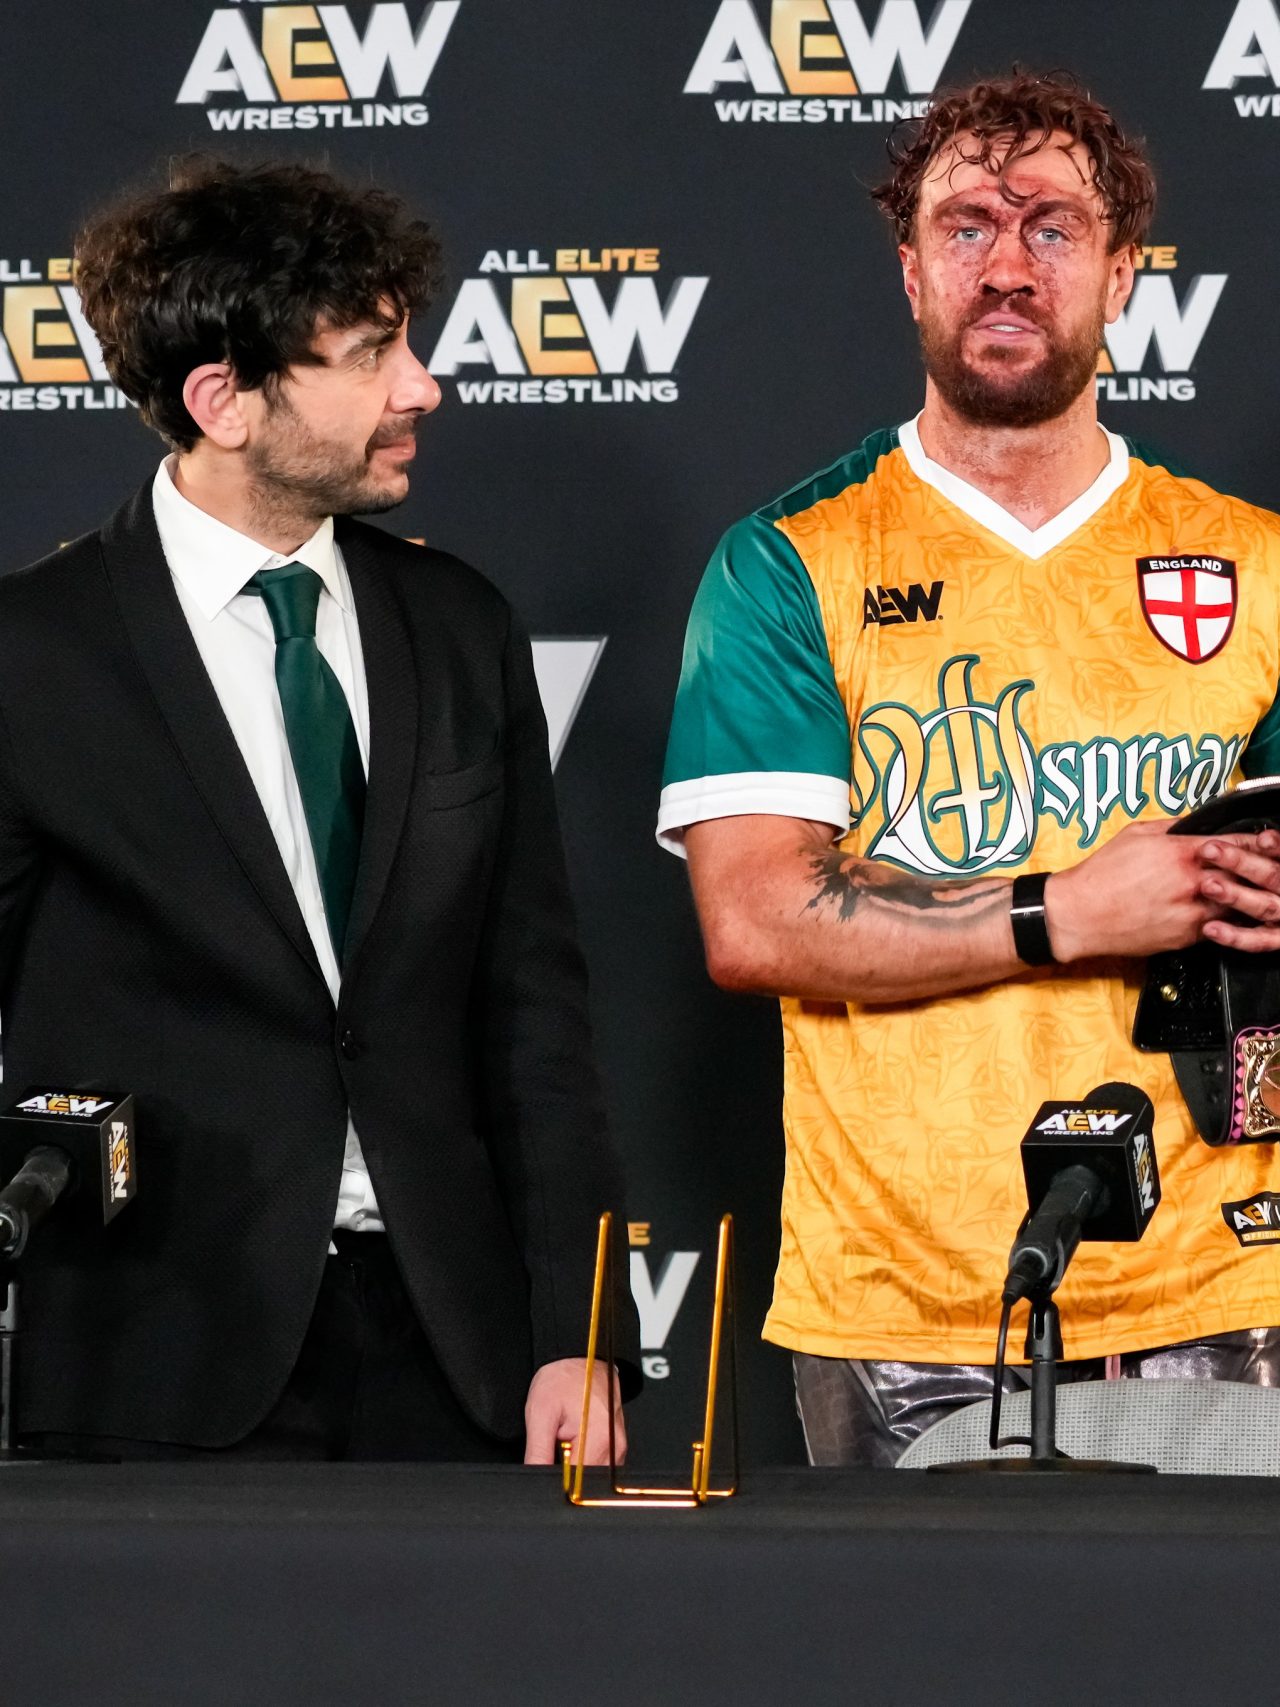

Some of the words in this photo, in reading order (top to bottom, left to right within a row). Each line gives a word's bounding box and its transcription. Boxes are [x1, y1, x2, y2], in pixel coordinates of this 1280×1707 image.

[175, 1, 461, 104] AEW
[682, 0, 973, 95] AEW
[206, 103, 430, 131] WRESTLING
[478, 249, 549, 272] ALL
[556, 248, 660, 272] ELITE
[428, 276, 711, 376] AEW
[457, 379, 679, 404] WRESTLING
[1149, 558, 1222, 572] ENGLAND
[863, 581, 944, 630] AEW
[16, 1095, 114, 1114] AEW
[1035, 1113, 1133, 1131] AEW
